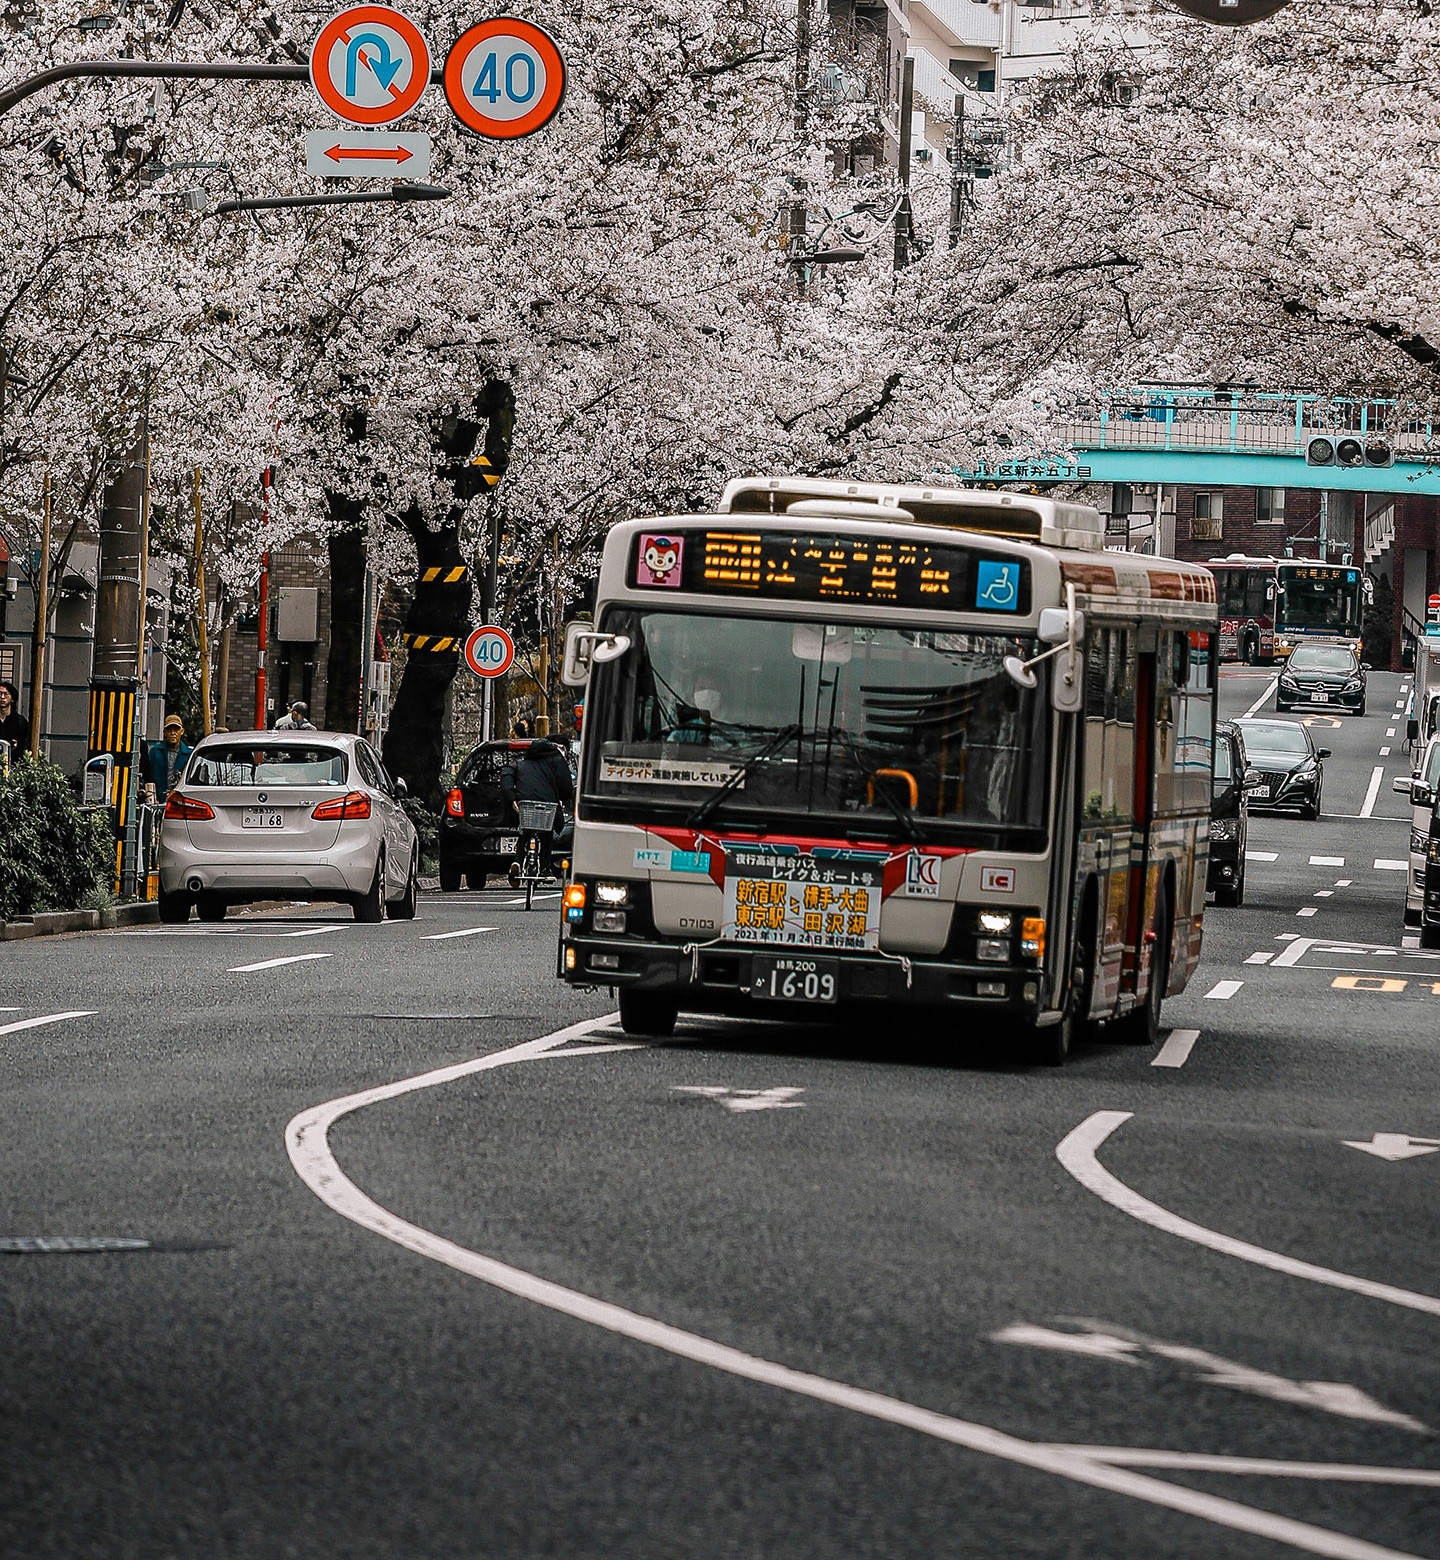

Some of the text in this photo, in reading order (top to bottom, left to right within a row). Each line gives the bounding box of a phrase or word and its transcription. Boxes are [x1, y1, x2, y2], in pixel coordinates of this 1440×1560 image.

[472, 52, 536, 104] 40
[476, 640, 503, 663] 40
[736, 879, 787, 905] 新宿駅
[679, 918, 715, 930] D7103
[735, 904, 868, 936] 東京駅 田沢湖
[770, 969, 835, 1001] 16-09
